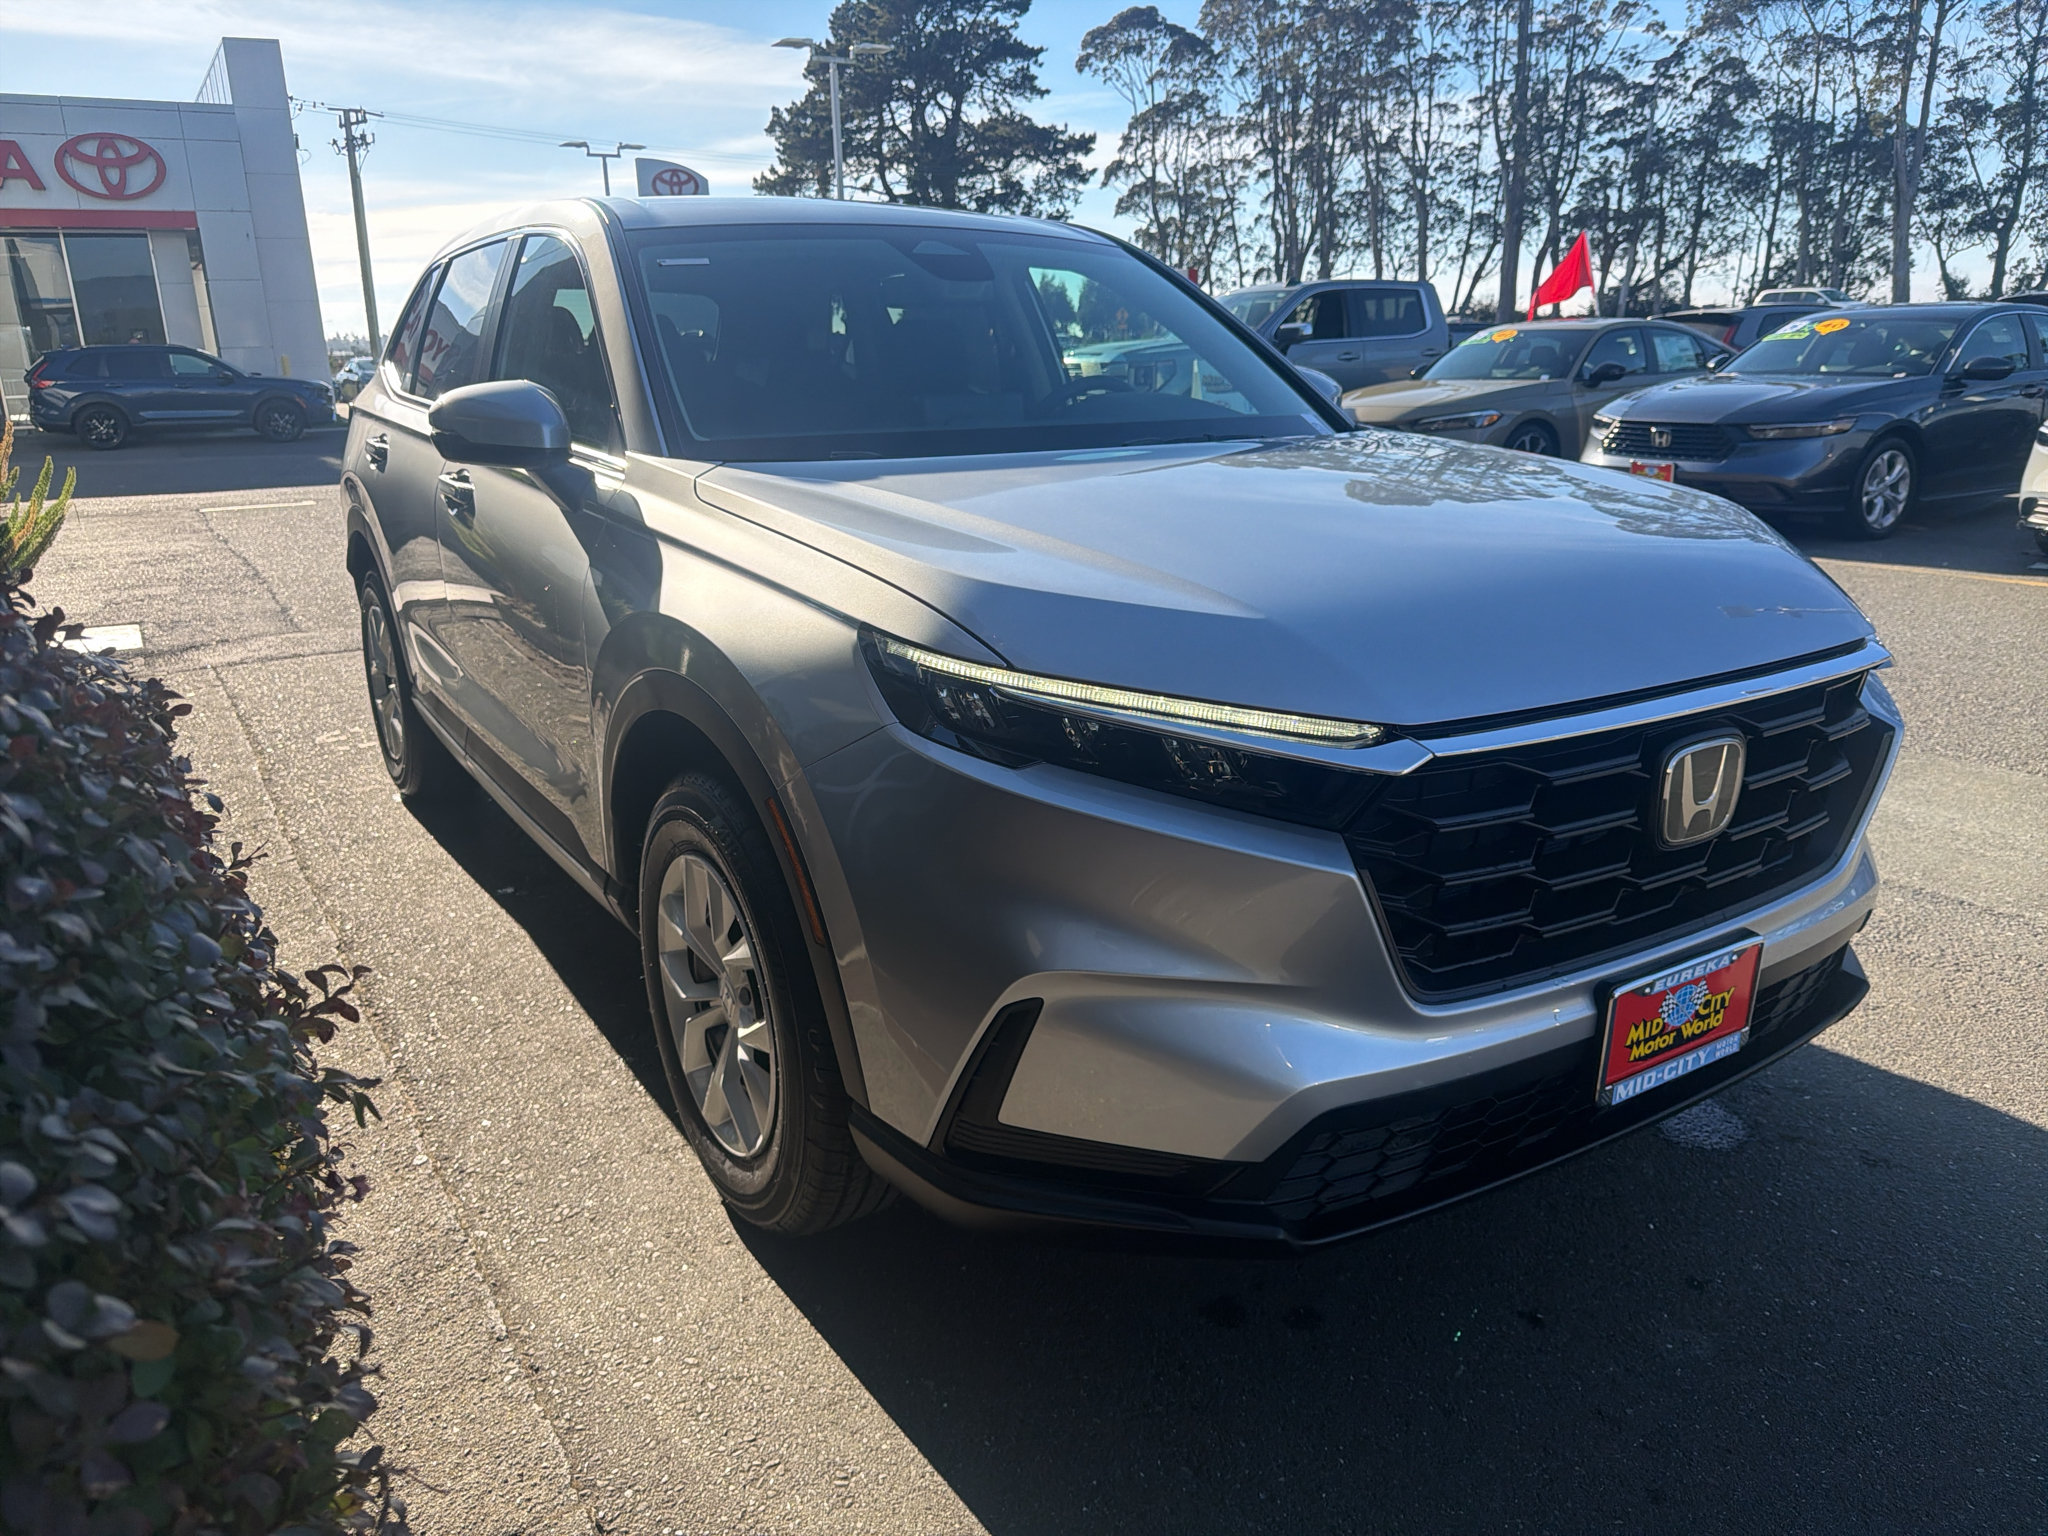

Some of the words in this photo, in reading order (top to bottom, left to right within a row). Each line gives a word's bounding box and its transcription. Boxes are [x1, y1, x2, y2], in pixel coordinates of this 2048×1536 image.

[1654, 956, 1731, 991] EUREKA
[1626, 1018, 1664, 1047] MID
[1699, 987, 1735, 1015] CITY
[1629, 1032, 1676, 1061] Motor
[1681, 1010, 1724, 1039] World
[1615, 1047, 1711, 1101] MID-CITY
